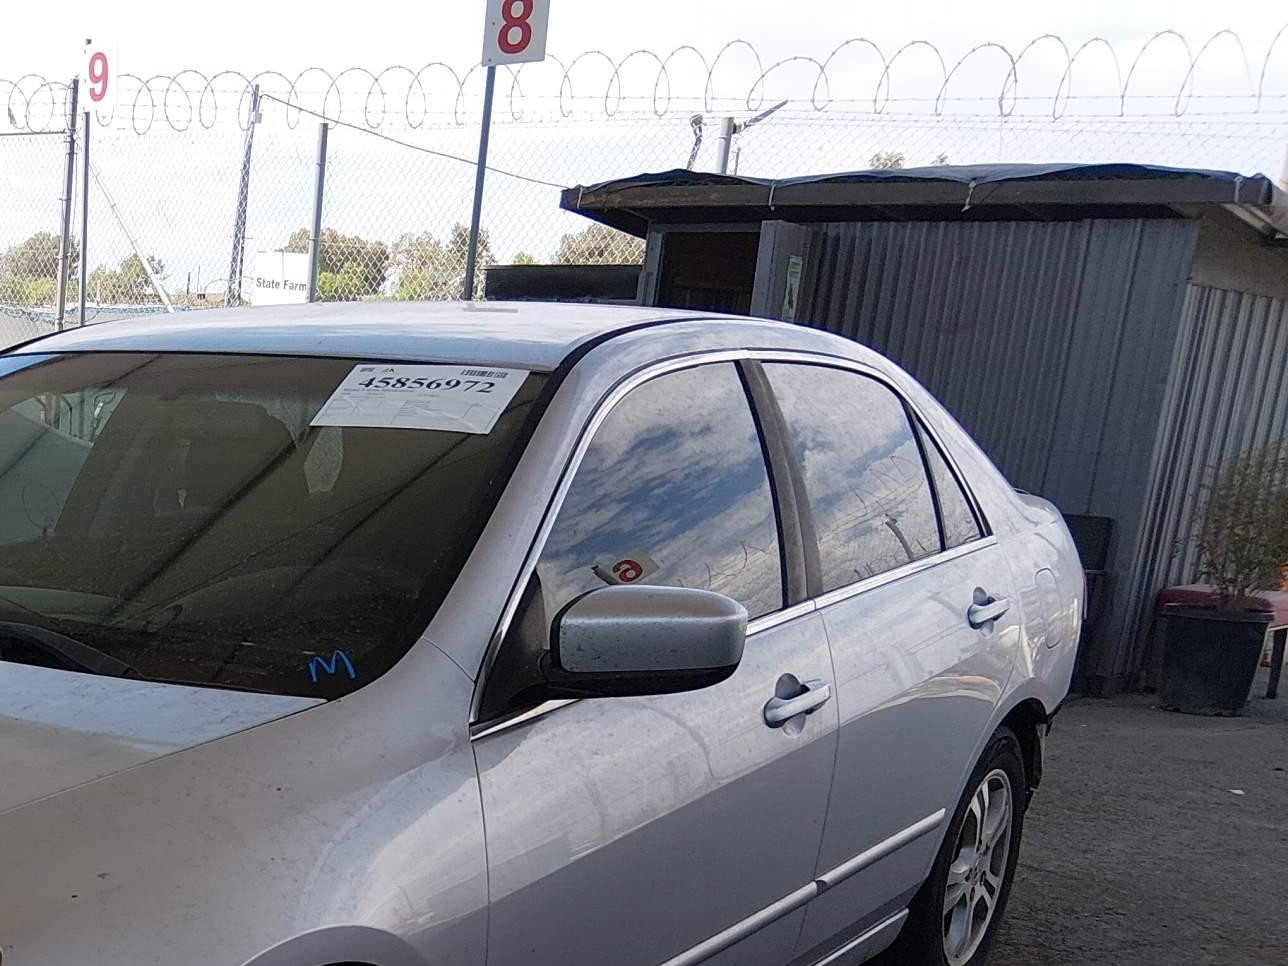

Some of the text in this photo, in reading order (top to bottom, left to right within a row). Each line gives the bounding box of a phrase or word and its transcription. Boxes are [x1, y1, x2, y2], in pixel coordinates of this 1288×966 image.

[497, 0, 534, 55] 8
[88, 51, 109, 102] 9
[255, 277, 307, 292] State Farm
[358, 376, 496, 394] 45856972
[309, 649, 355, 682] M
